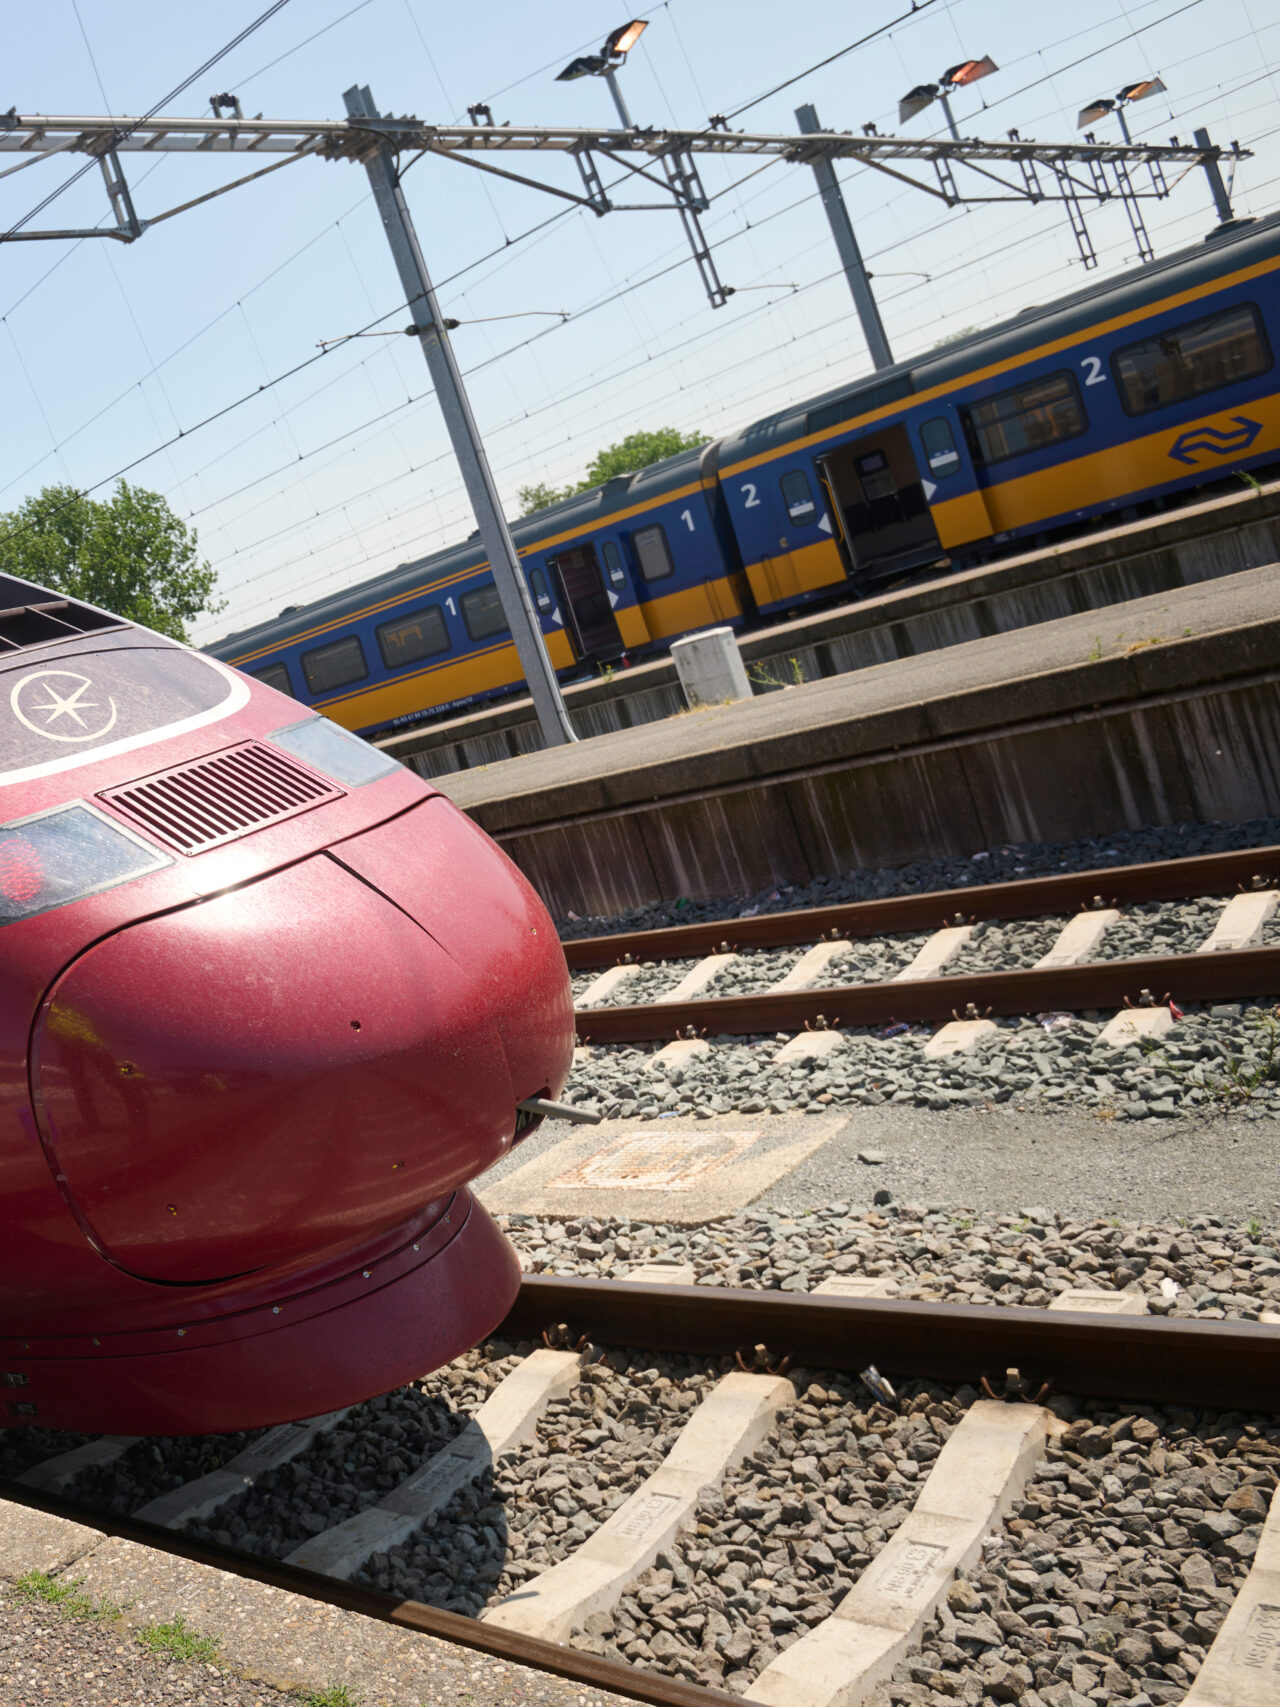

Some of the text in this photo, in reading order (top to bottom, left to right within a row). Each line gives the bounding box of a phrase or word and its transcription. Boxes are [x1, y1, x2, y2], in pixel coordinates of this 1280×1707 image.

[1080, 356, 1107, 386] 2
[740, 483, 761, 508] 2
[680, 509, 696, 532] 1
[445, 596, 457, 616] 1
